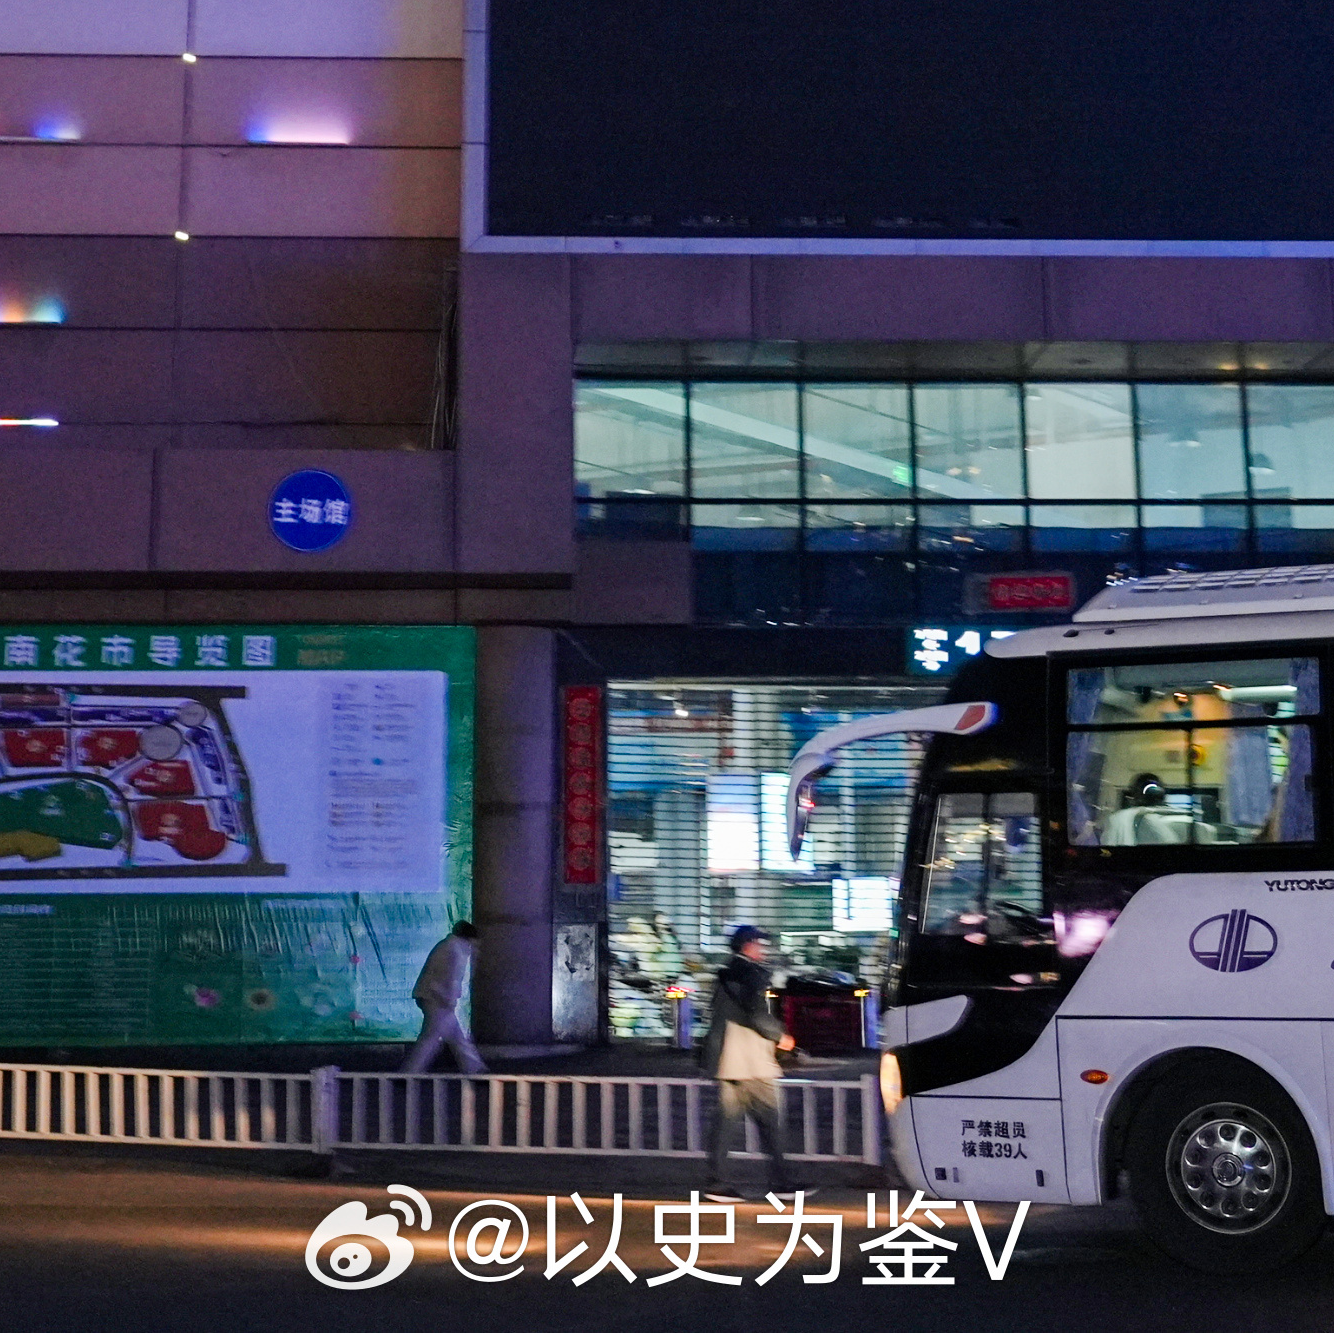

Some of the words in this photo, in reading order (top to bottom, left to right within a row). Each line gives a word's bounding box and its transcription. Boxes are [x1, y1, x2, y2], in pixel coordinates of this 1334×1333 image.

[273, 497, 350, 525] 主场馆
[961, 1119, 1027, 1139] 严禁超员
[961, 1140, 1028, 1160] 核载39人
